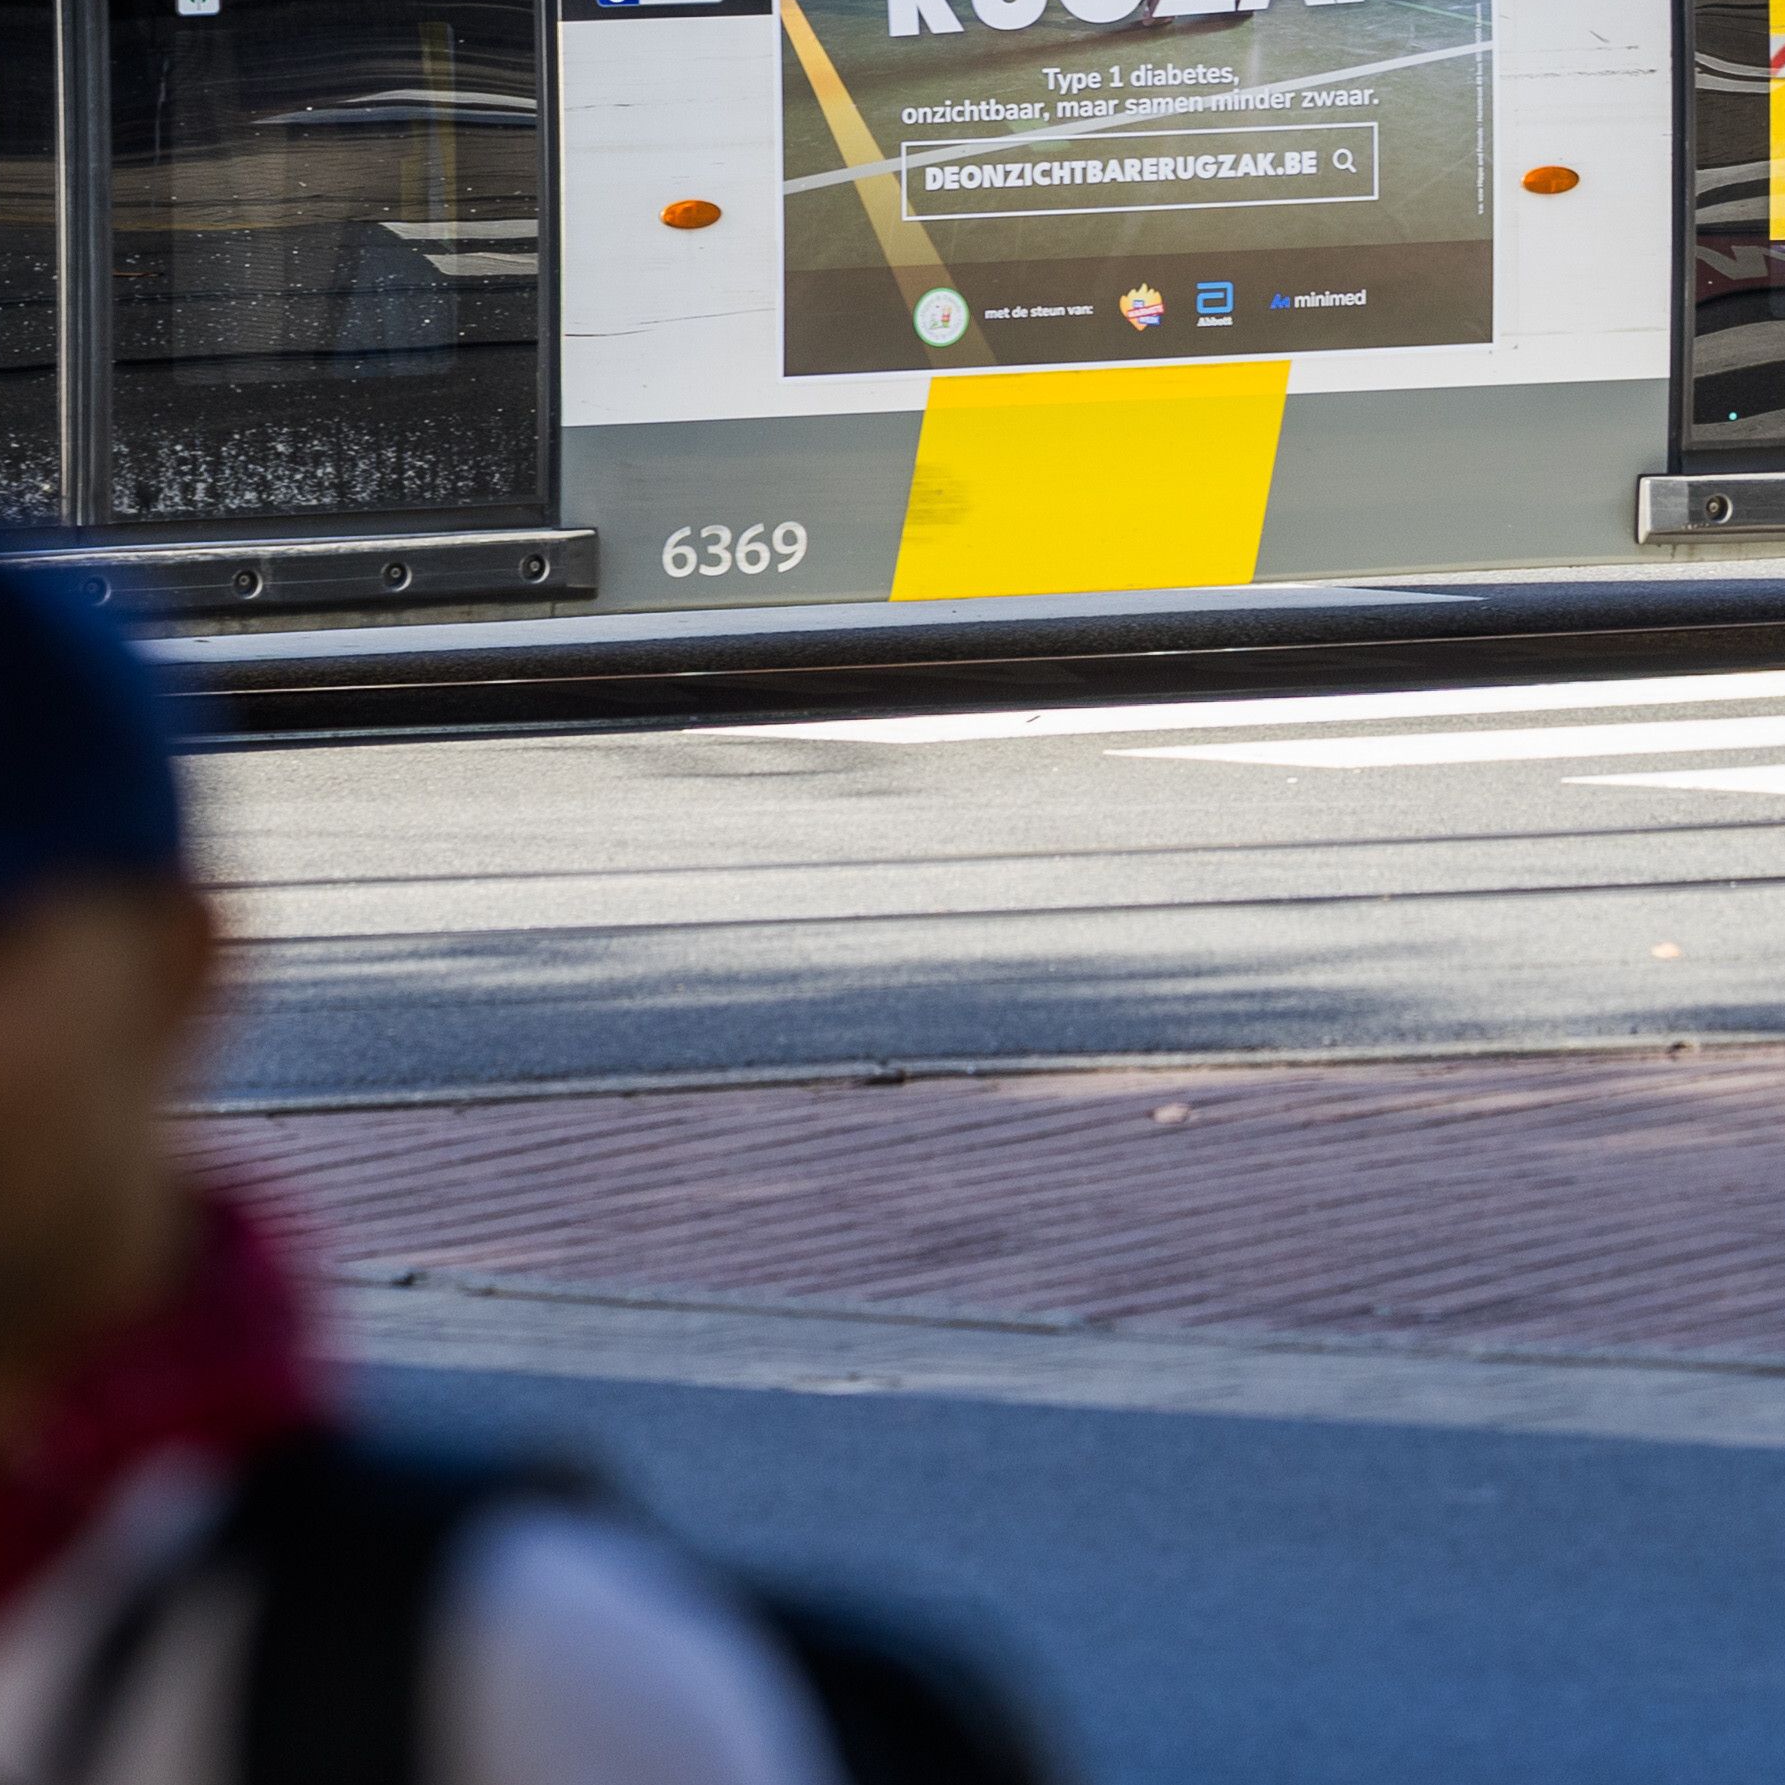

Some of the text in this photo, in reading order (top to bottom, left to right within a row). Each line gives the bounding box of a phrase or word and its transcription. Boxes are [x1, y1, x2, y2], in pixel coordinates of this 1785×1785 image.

[1042, 63, 1240, 94] Type 1 diabetes,
[902, 88, 1379, 124] onzichtbaar, maar samen minder zwaar.
[925, 150, 1317, 191] DEONZICHTBARERUGZAK.BE
[985, 306, 1094, 319] met de steun van:
[1294, 289, 1367, 308] minimed
[662, 520, 808, 578] 6369
